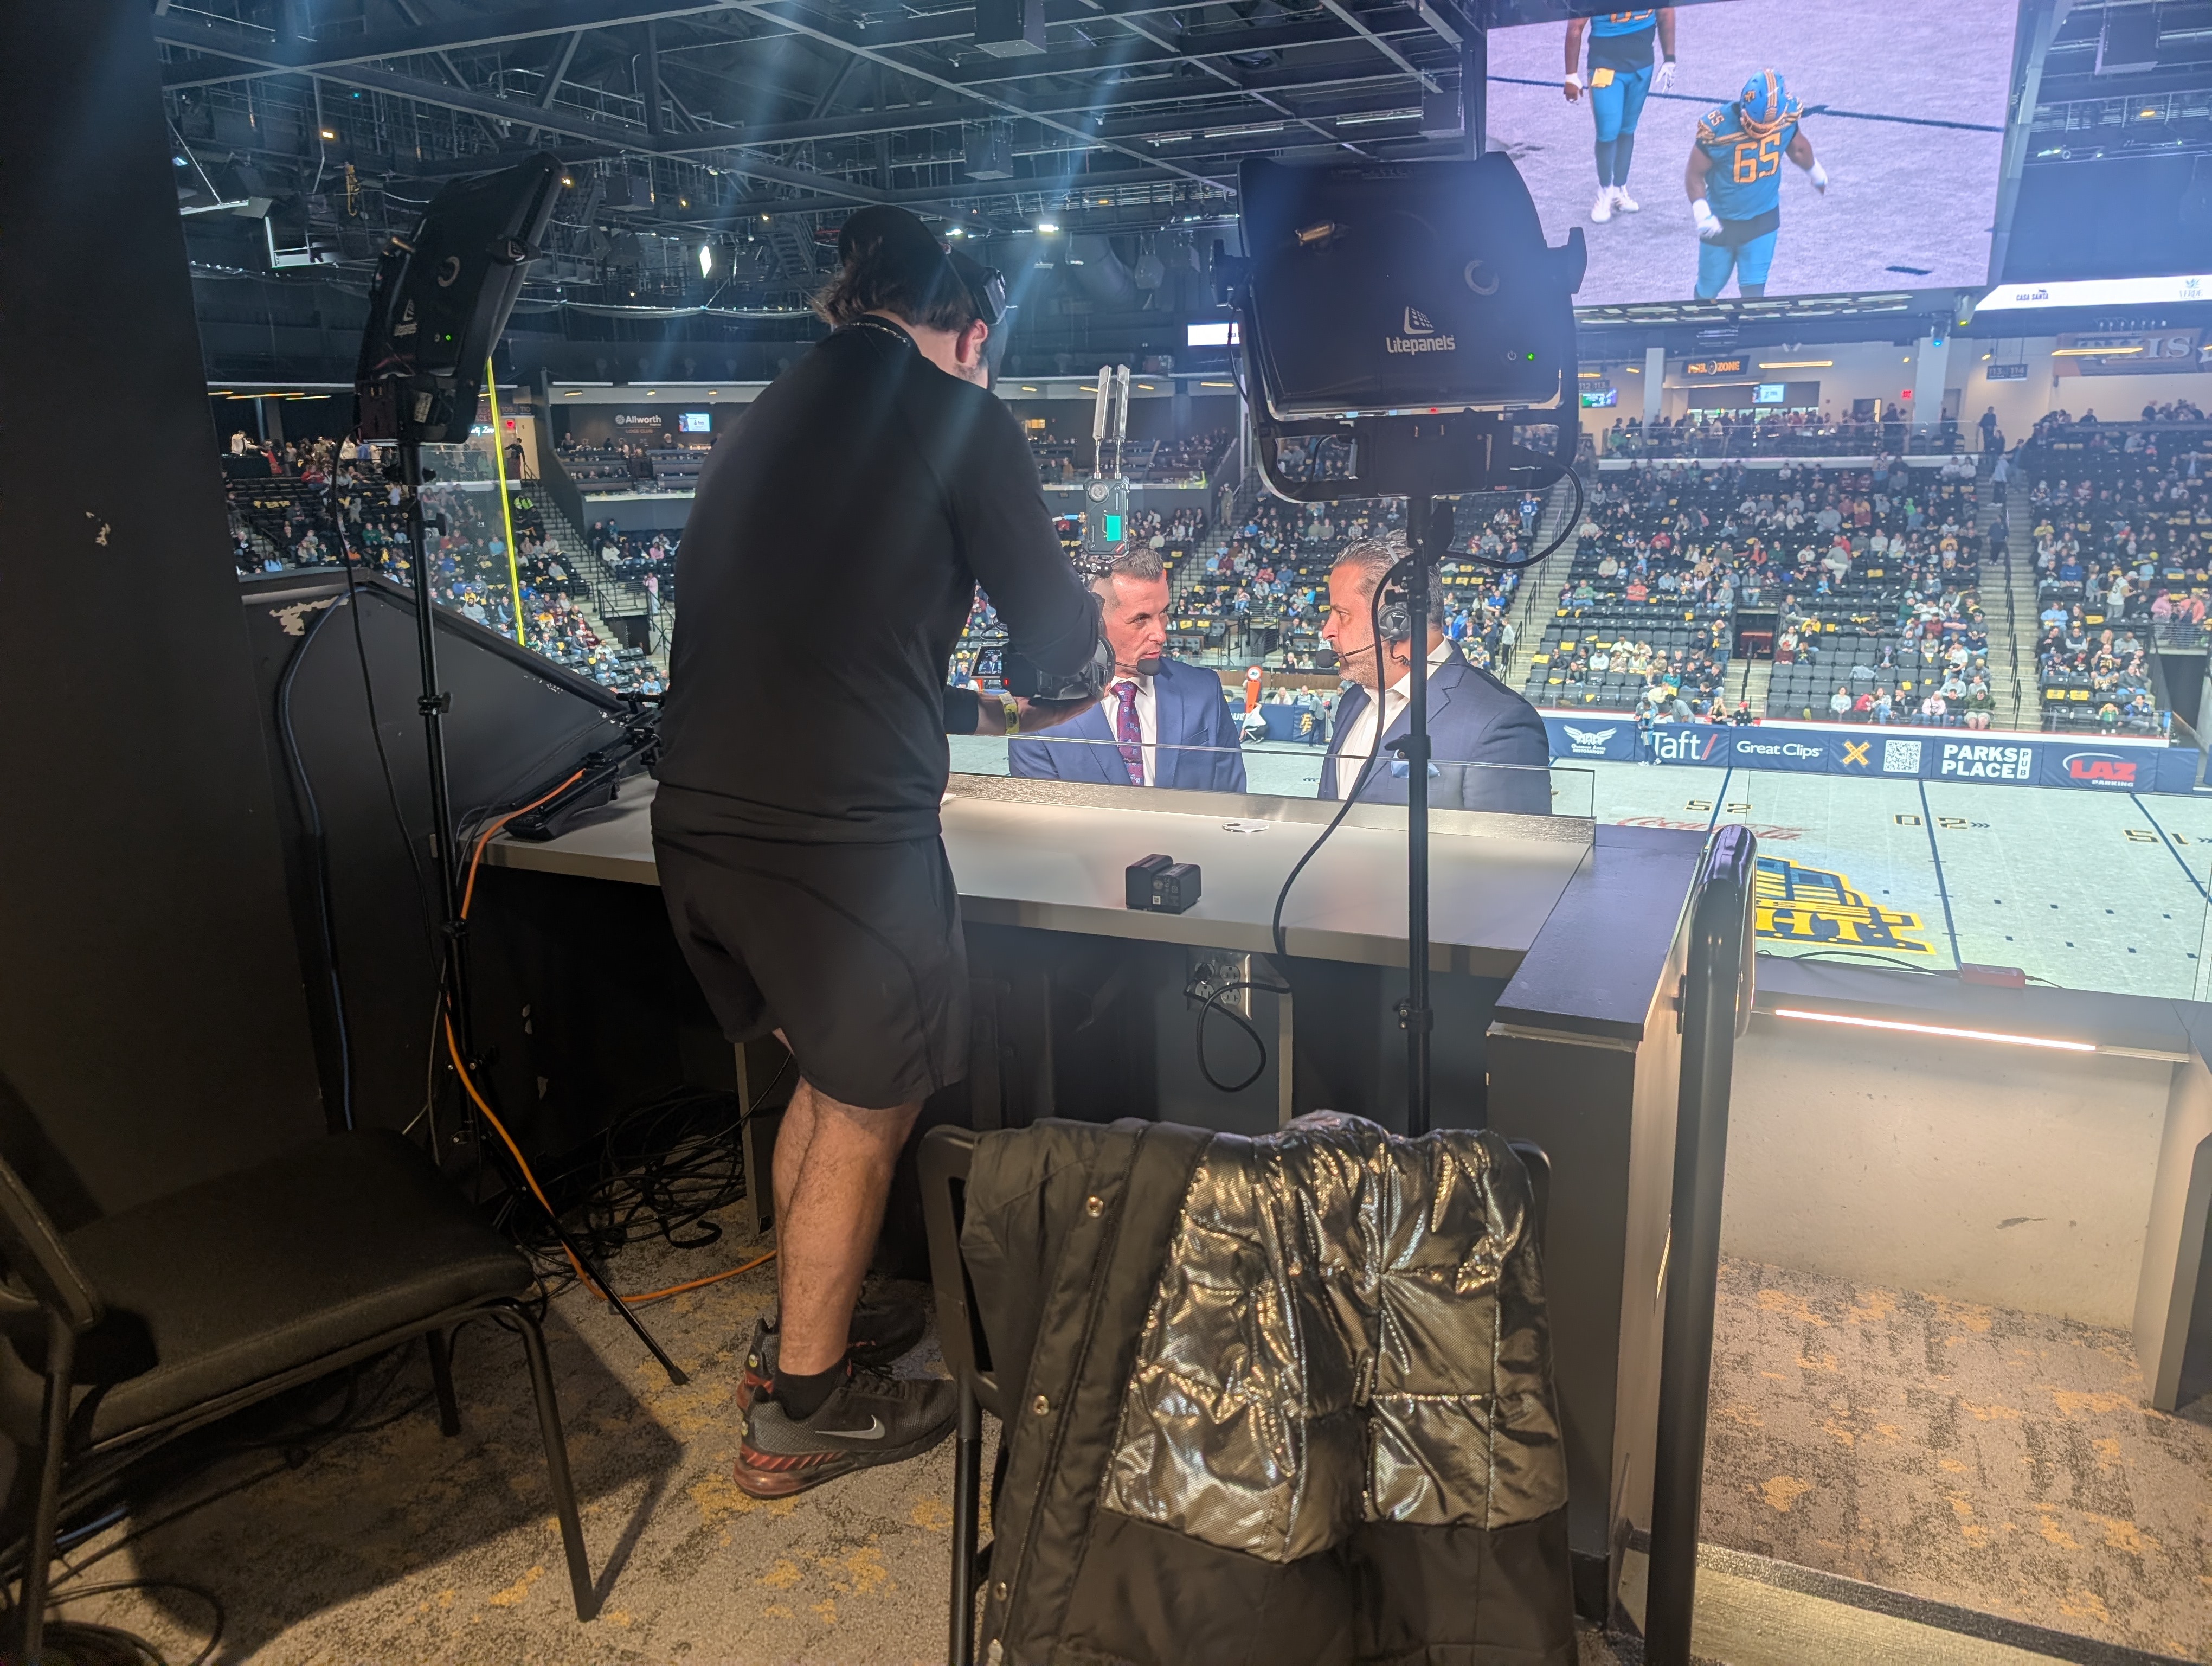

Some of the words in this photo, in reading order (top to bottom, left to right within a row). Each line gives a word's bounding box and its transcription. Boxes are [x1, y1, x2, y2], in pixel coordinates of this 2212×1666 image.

[1733, 132, 1781, 183] 65
[2016, 293, 2030, 302] CASA
[2031, 292, 2049, 300] SANTA
[1386, 335, 1456, 355] Litepanels
[1717, 360, 1740, 372] ZONE
[625, 415, 662, 424] Allworth
[1737, 740, 1780, 755] Great
[1943, 744, 2018, 762] PARKS
[1941, 760, 2015, 779] PLACE
[2020, 751, 2029, 776] PUB
[2070, 760, 2137, 781] LAZ
[2092, 779, 2134, 787] PARKING
